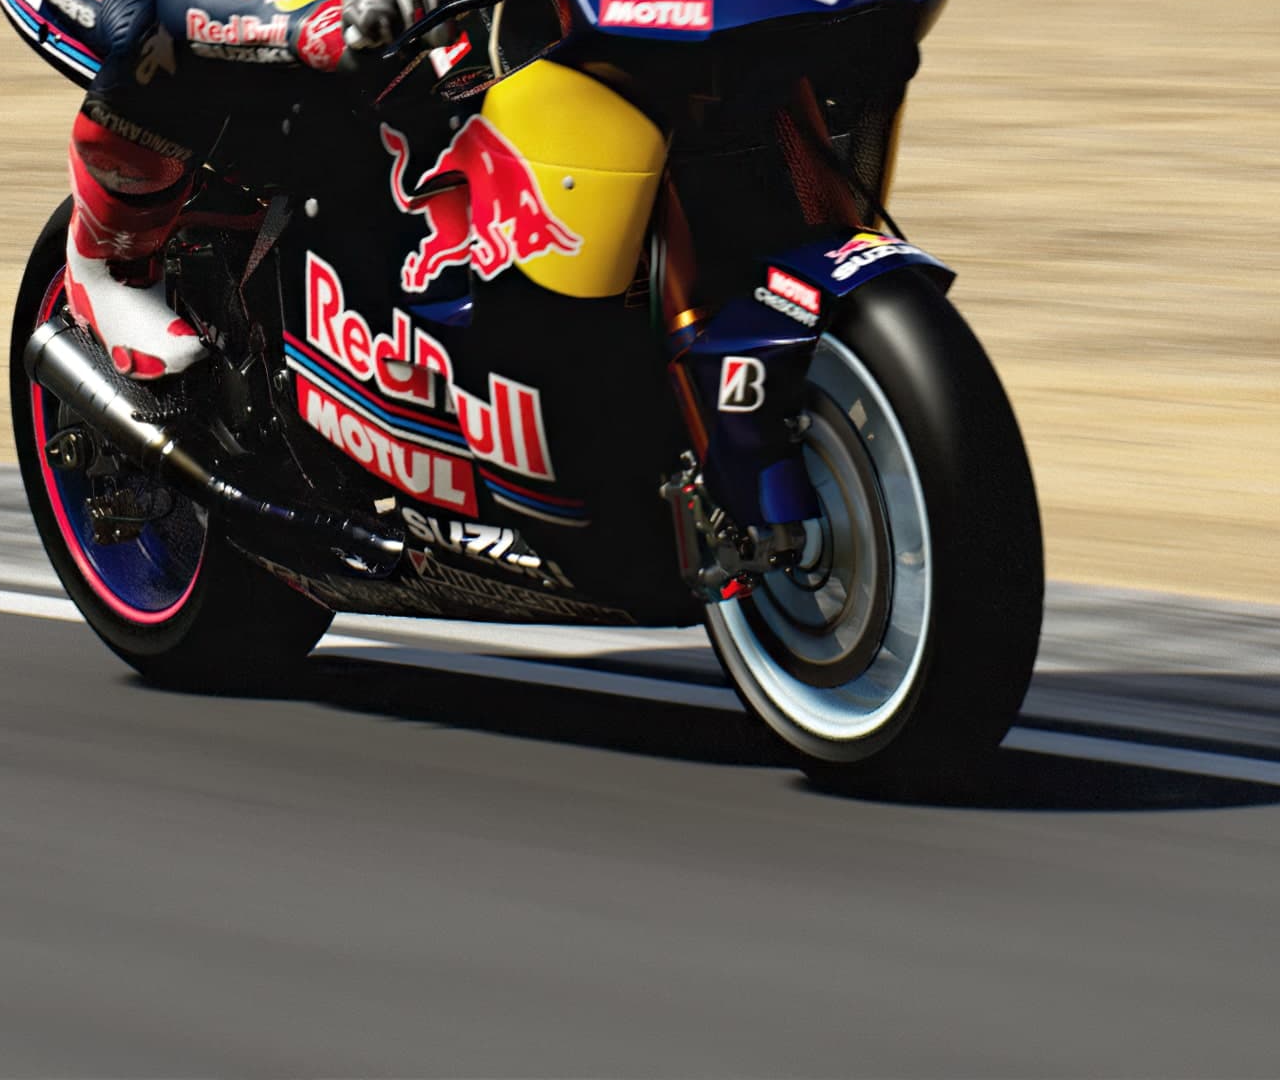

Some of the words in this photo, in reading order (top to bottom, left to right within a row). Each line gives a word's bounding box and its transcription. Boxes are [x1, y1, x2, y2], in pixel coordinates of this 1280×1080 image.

[770, 270, 819, 312] MOTUL
[307, 387, 466, 506] MOTUL
[401, 506, 576, 589] SUZI
